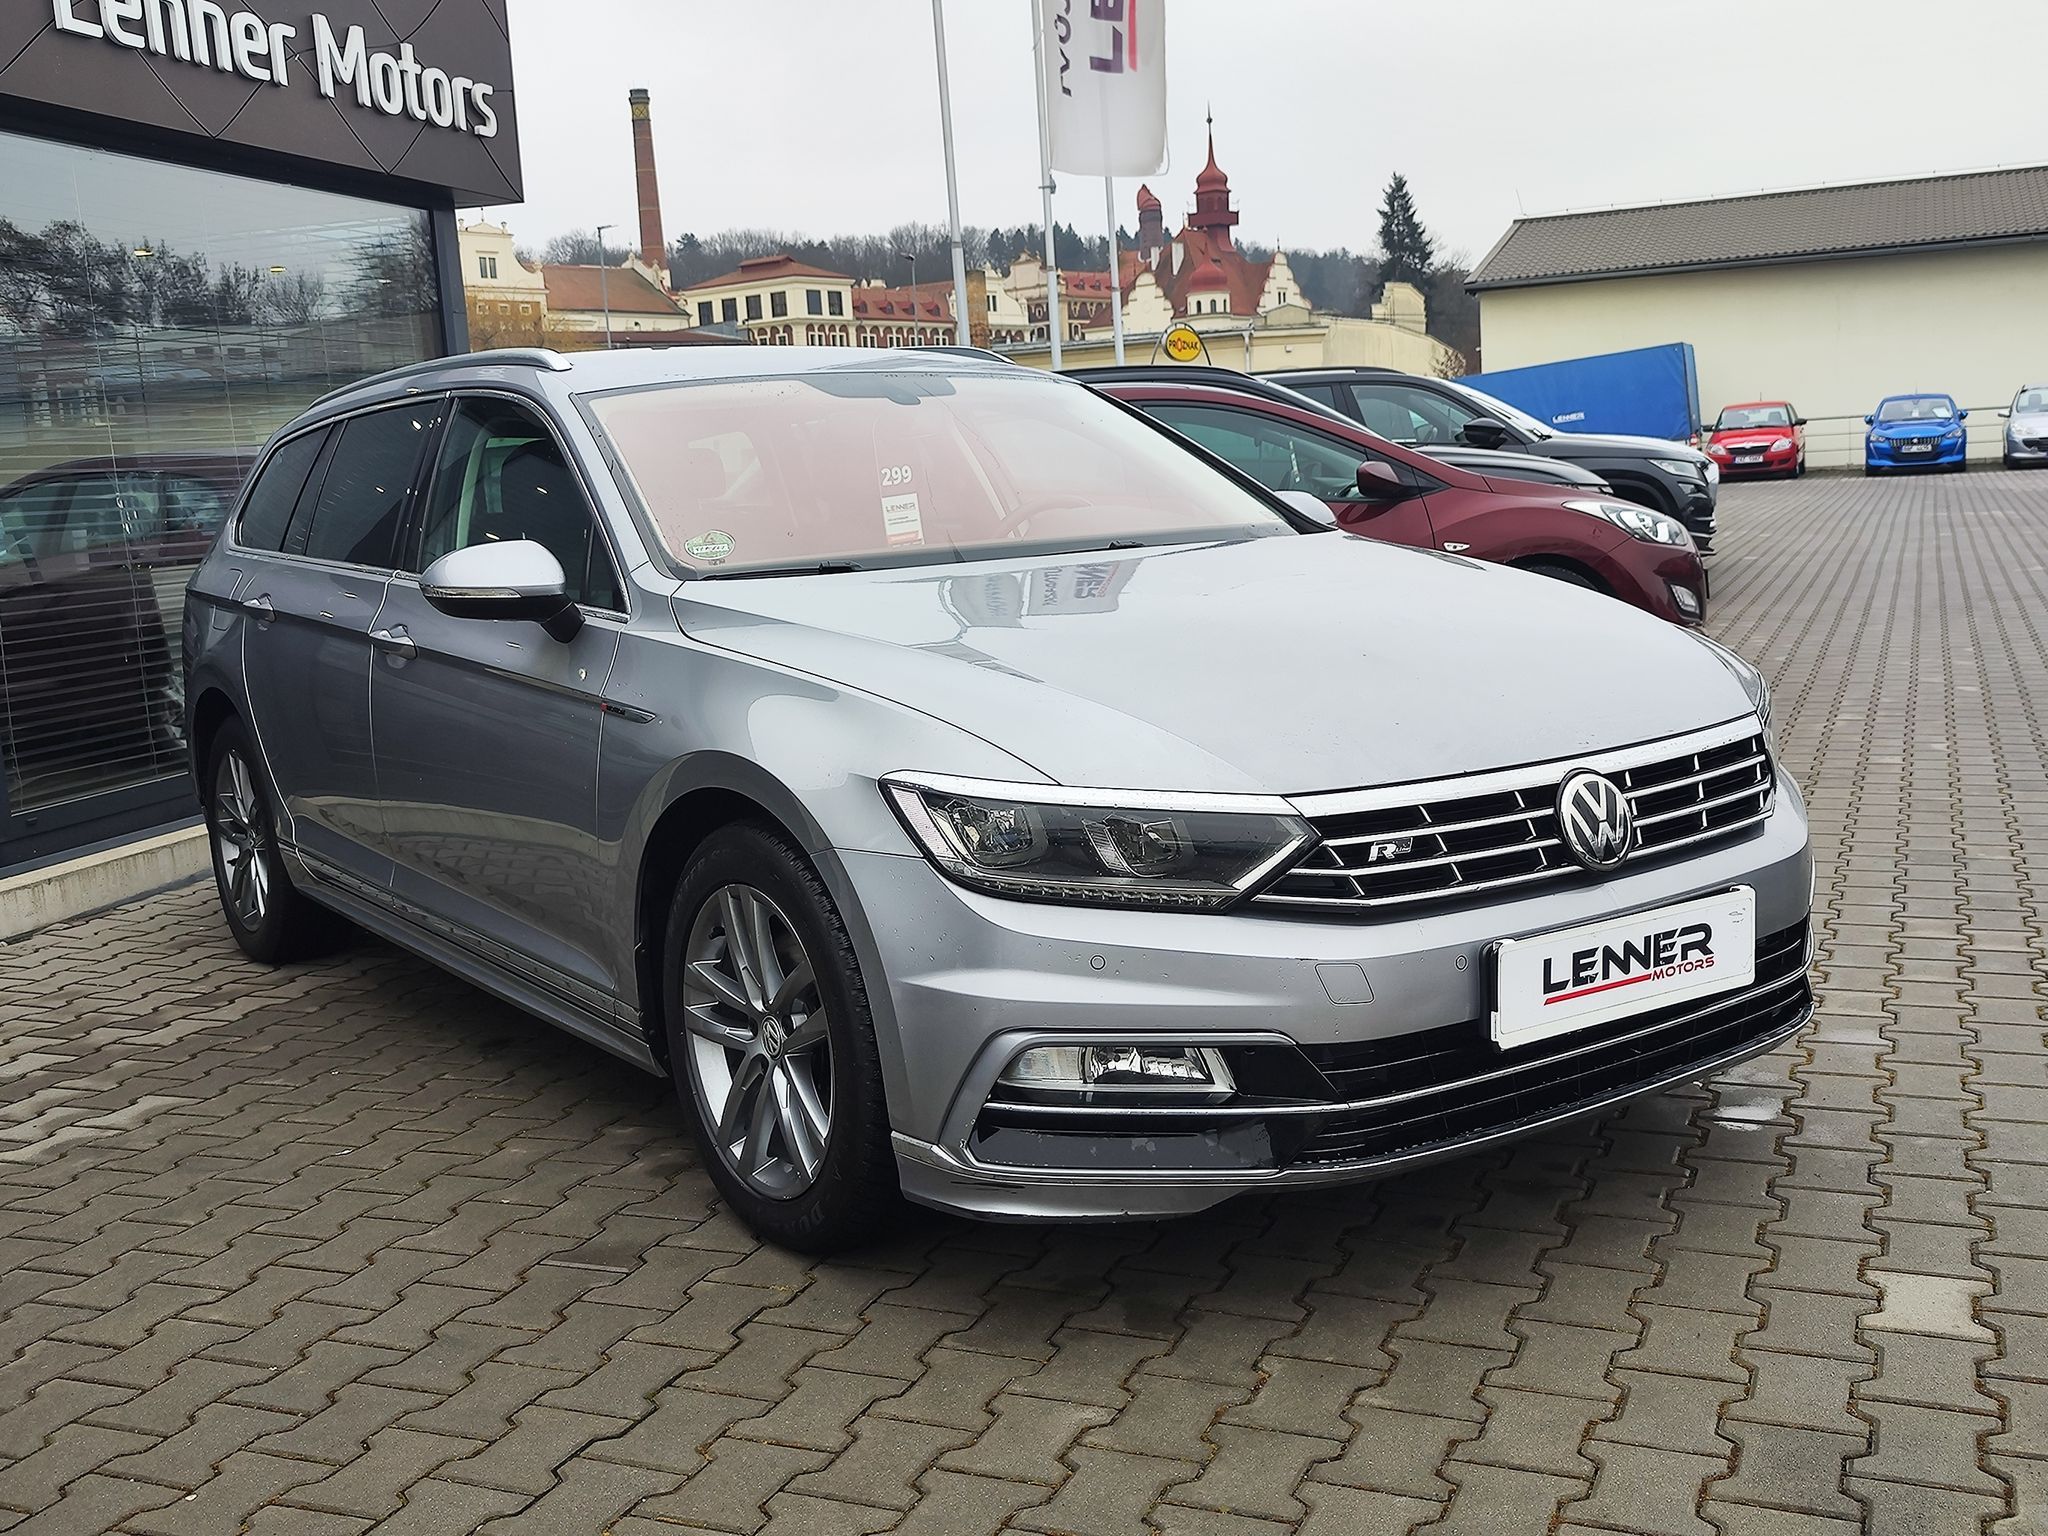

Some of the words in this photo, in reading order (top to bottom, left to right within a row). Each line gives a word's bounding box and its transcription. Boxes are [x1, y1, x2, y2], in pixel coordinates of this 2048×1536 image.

[311, 12, 499, 138] Motors
[880, 464, 913, 487] 299
[885, 502, 916, 513] LENNER
[1543, 922, 1715, 995] LENNER
[1651, 956, 1716, 982] MOTORS
